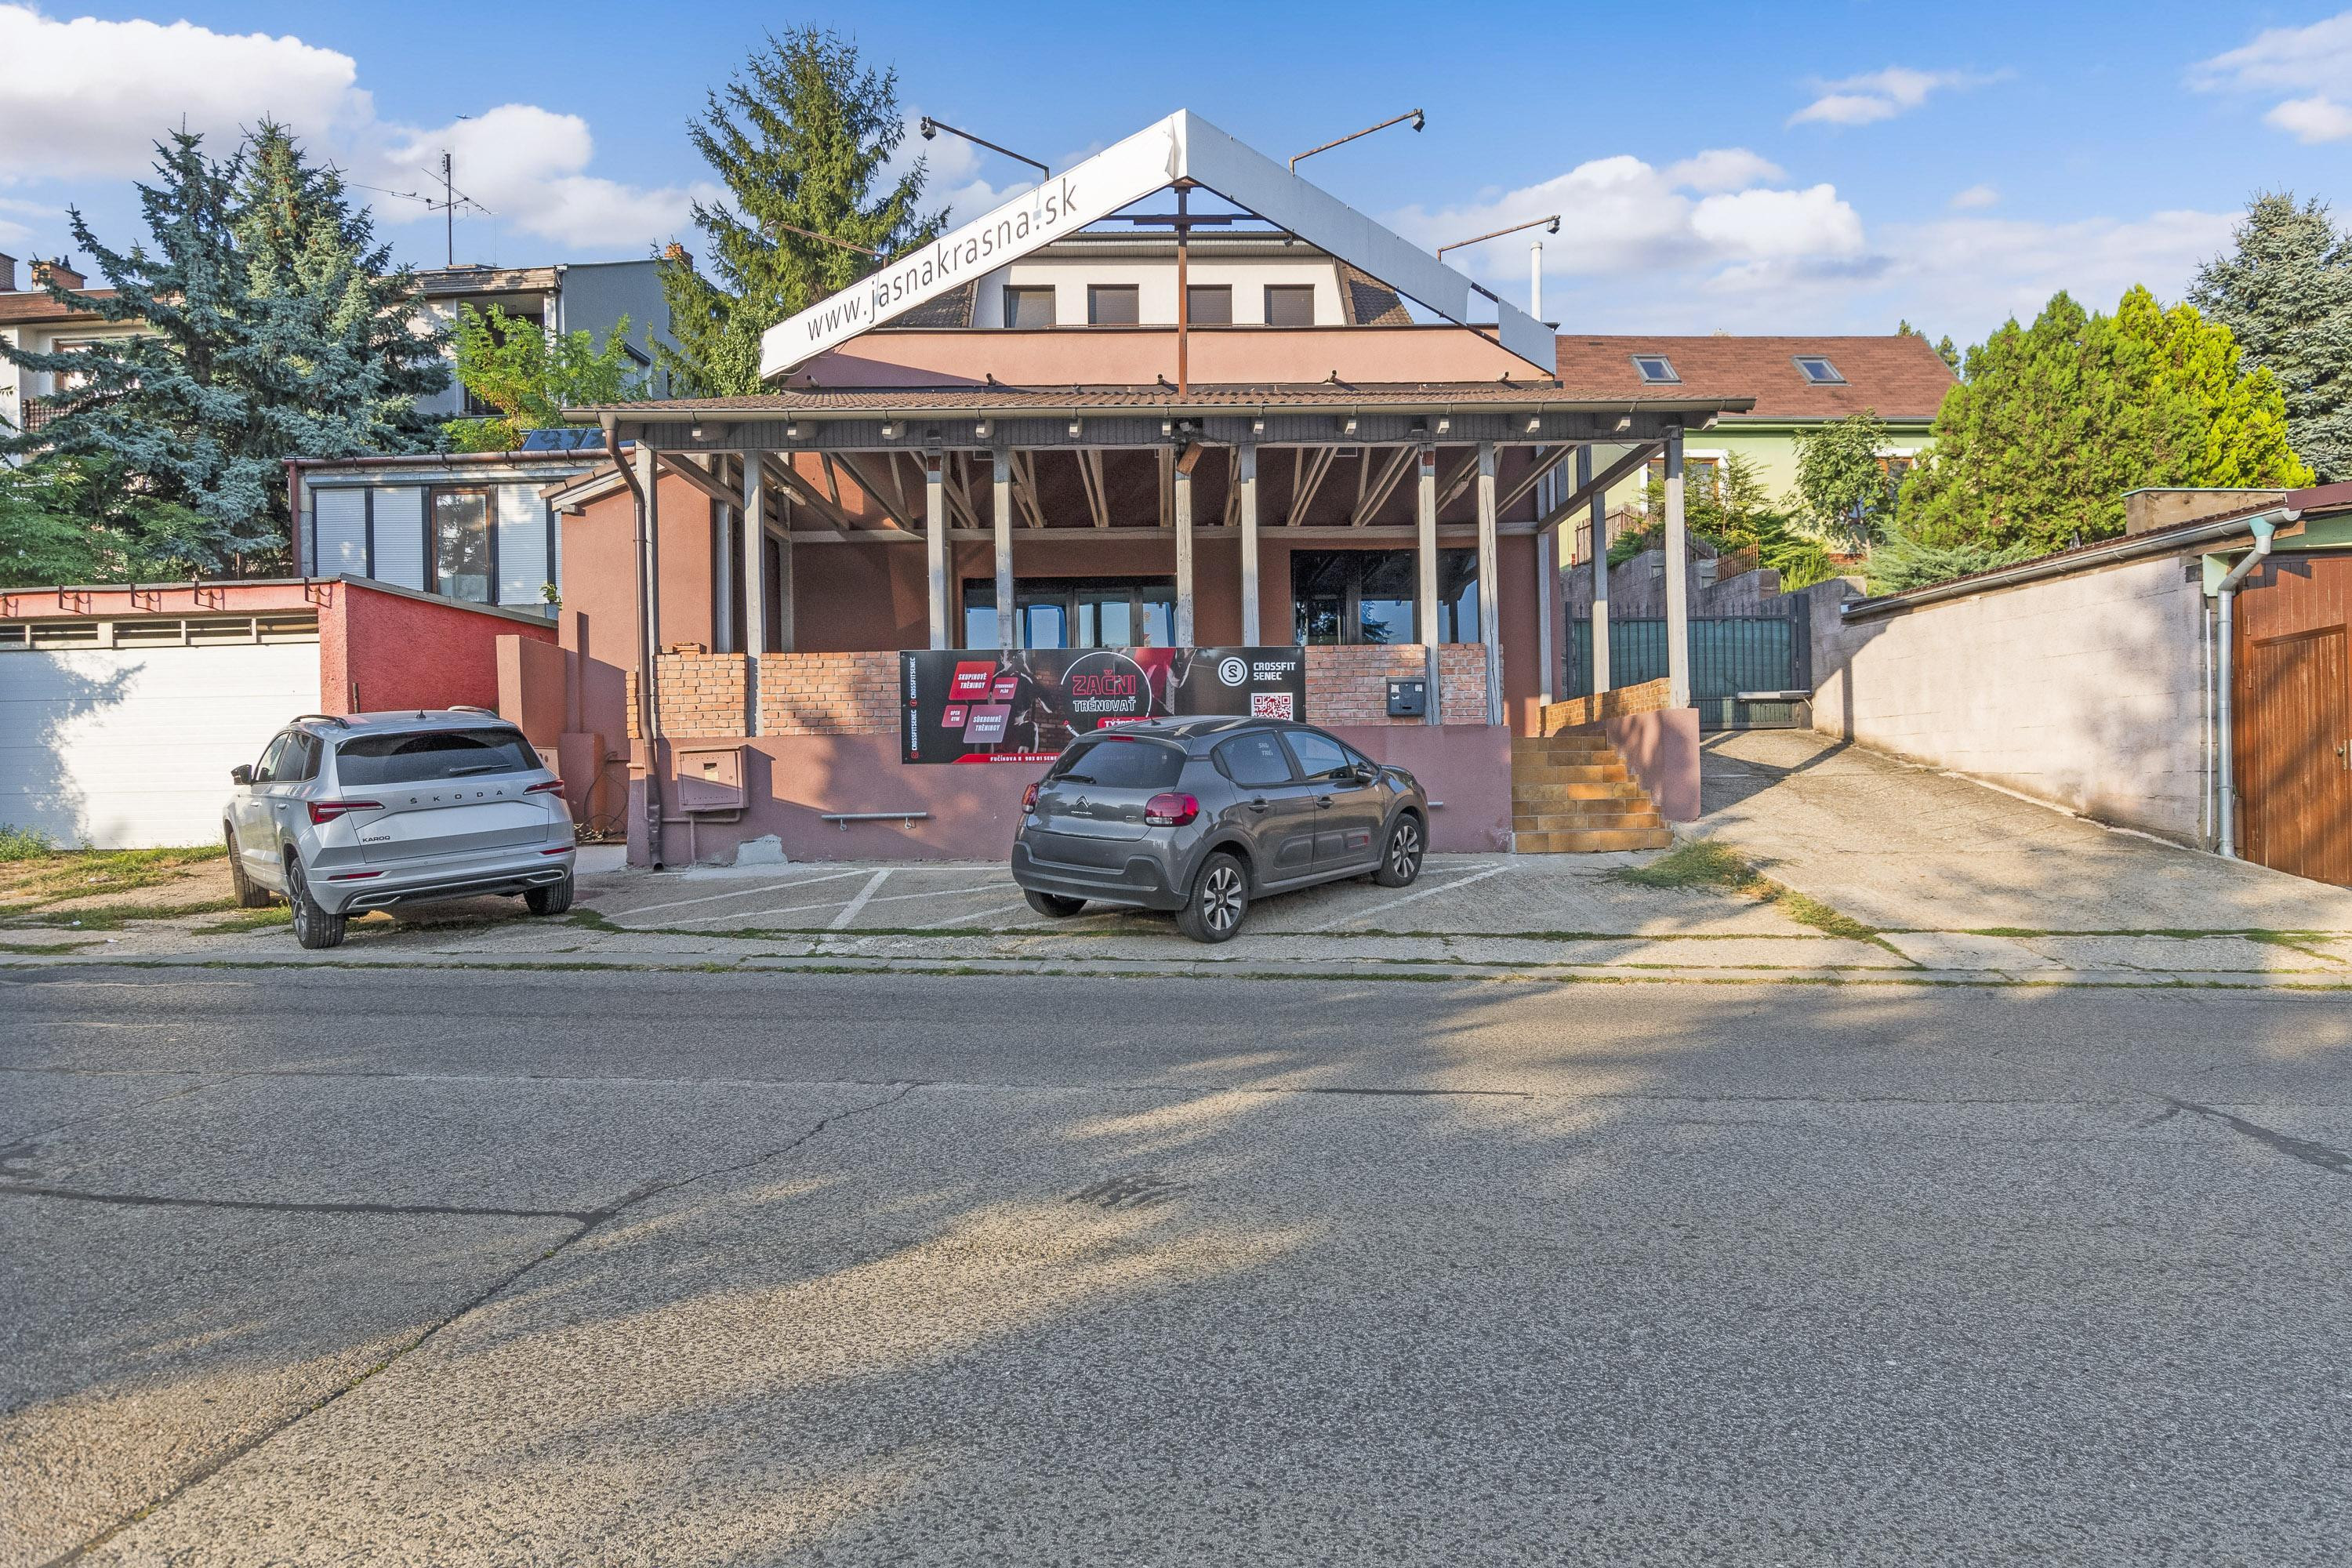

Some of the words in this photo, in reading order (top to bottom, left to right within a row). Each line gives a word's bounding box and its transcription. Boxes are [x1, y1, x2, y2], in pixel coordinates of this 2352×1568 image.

[808, 178, 1077, 341] www.jasnakrasna.sk
[1253, 662, 1296, 671] CROSSFIT
[1073, 669, 1136, 695] ZAČNI
[1253, 672, 1283, 681] SENEC
[1073, 696, 1136, 712] TRÉNOVAŤ
[409, 789, 504, 805] ŠKODA
